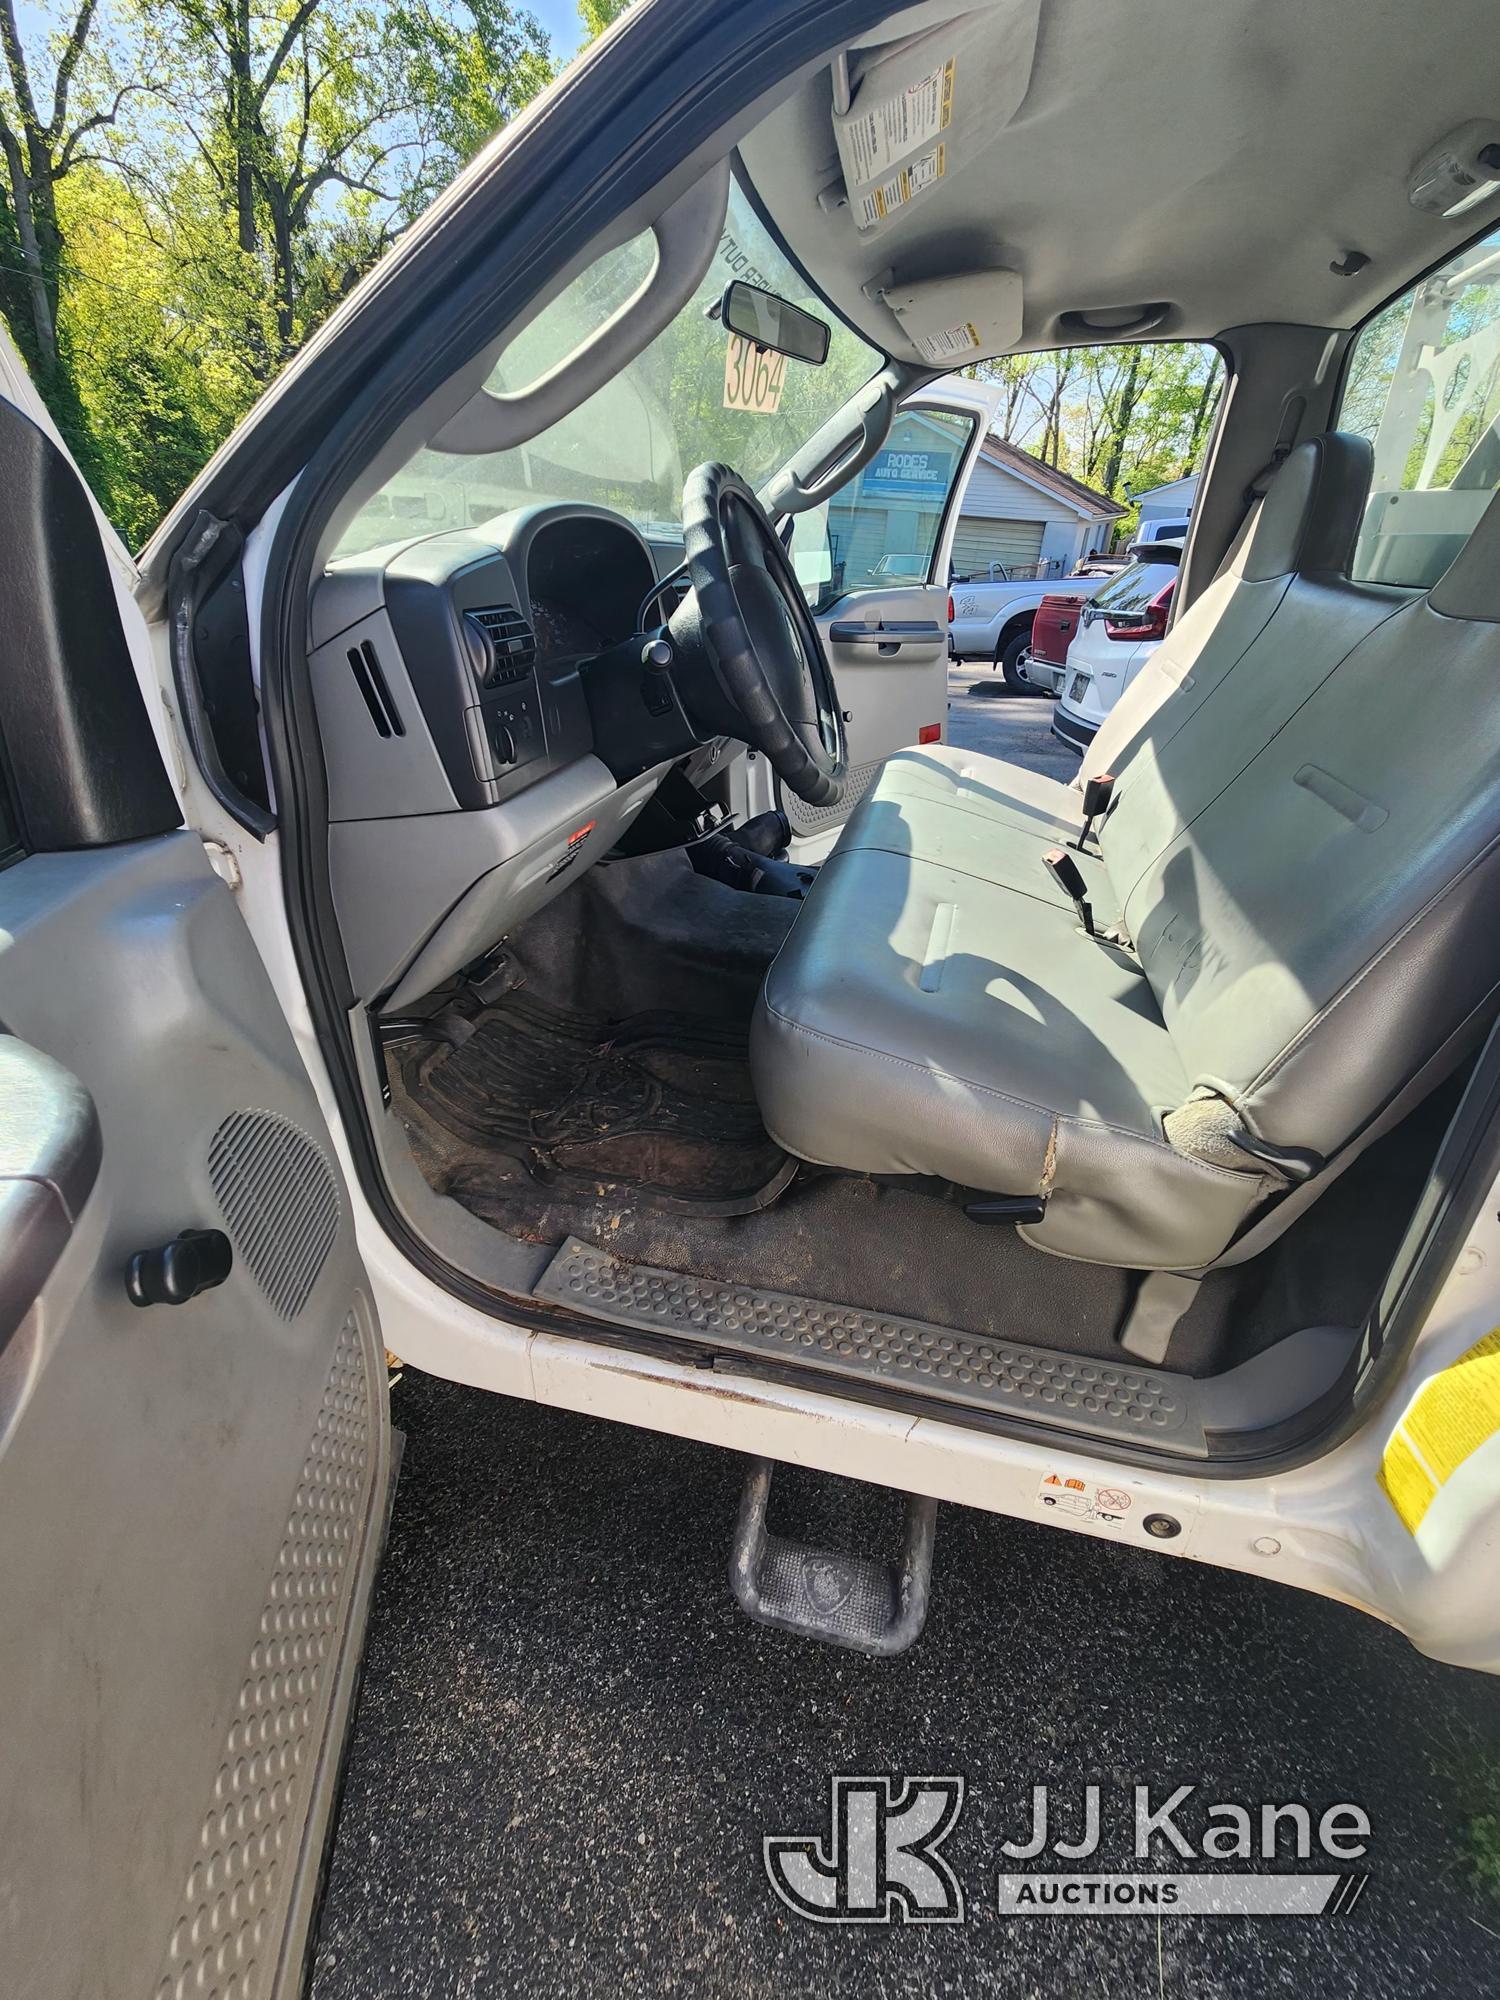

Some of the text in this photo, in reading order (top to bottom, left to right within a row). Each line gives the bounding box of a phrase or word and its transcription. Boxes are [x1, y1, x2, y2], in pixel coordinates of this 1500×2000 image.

[728, 334, 784, 408] 3064
[887, 453, 929, 467] RODES
[875, 467, 939, 480] AUTO SERVICE
